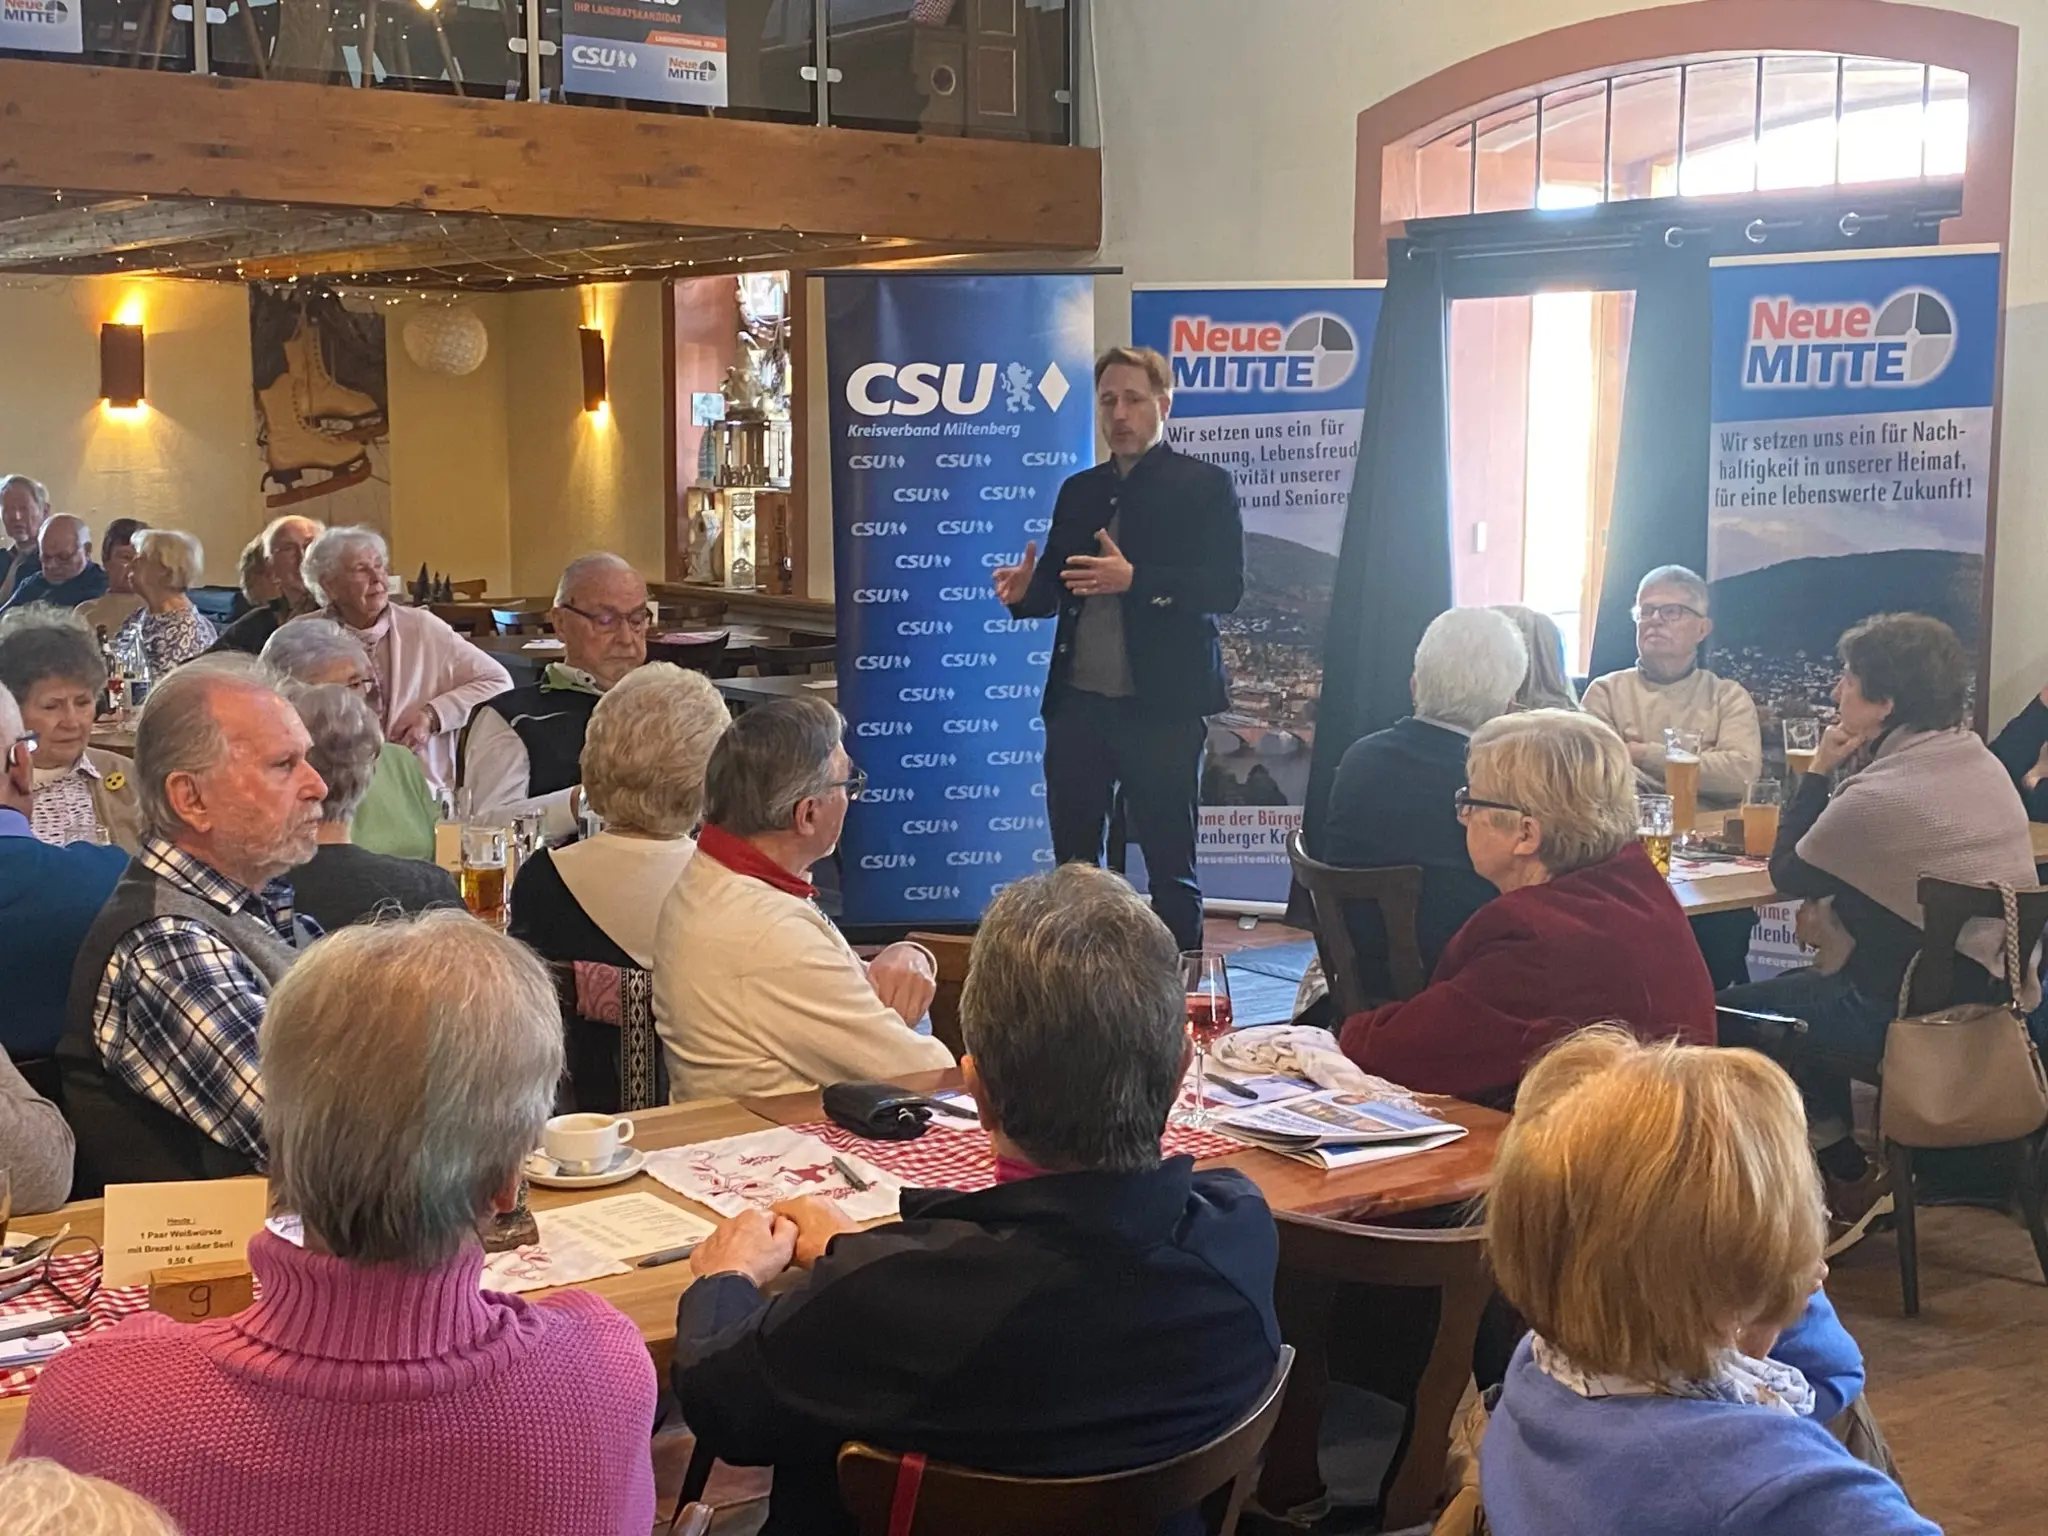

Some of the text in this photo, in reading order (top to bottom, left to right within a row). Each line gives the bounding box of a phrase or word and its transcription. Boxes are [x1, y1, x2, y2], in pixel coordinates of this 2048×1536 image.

[574, 2, 590, 13] IHR
[4, 8, 55, 23] MITTE
[572, 45, 617, 67] CSU
[669, 56, 698, 70] Neue
[668, 68, 708, 81] MITTE
[1753, 300, 1871, 340] Neue
[1174, 320, 1282, 353] Neue
[1746, 342, 1907, 383] MITTE
[1172, 355, 1314, 388] MITTE
[846, 361, 998, 417] CSU
[847, 421, 1021, 438] Kreisverband Miltenberg
[1168, 418, 1345, 443] Wir setzen uns ein für
[1720, 419, 1966, 452] Wir setzen uns ein für Nach-
[1261, 440, 1358, 463] Lebensfreud
[849, 455, 889, 469] CSU
[936, 454, 975, 468] CSU
[1022, 452, 1061, 467] CSU
[1720, 450, 1966, 485] haltigkeit in unserer Heimat,
[1280, 468, 1341, 484] unserer
[893, 488, 932, 503] CSU
[980, 486, 1018, 501] CSU
[1252, 490, 1280, 508] und
[1715, 477, 1972, 507] für eine lebenswerte Zukunft!
[851, 522, 889, 536] CSU
[937, 520, 976, 535] CSU
[895, 554, 934, 569] CSU
[853, 588, 892, 603] CSU
[939, 587, 977, 601] CSU
[897, 621, 936, 636] CSU
[983, 618, 1022, 633] CSU
[855, 655, 894, 670] CSU
[941, 653, 979, 668] CSU
[1027, 651, 1051, 666] CS
[899, 688, 938, 703] CSU
[985, 685, 1023, 700] CSU
[857, 722, 896, 737] CSU
[943, 719, 981, 734] CSU
[901, 754, 940, 769] CSU
[987, 751, 1025, 766] CSU
[944, 785, 982, 800] CSU
[988, 817, 1027, 832] CSU
[1229, 810, 1254, 826] der
[1258, 809, 1301, 830] Bürge
[902, 820, 941, 835] CSU
[860, 854, 899, 870] CSU
[946, 851, 985, 866] CSU
[1032, 849, 1055, 863] CS
[904, 886, 943, 901] CSU
[147, 1231, 168, 1239] Paar
[170, 1229, 222, 1238] Weißwürste
[145, 1244, 173, 1253] Brezel
[213, 1241, 234, 1249] Senf
